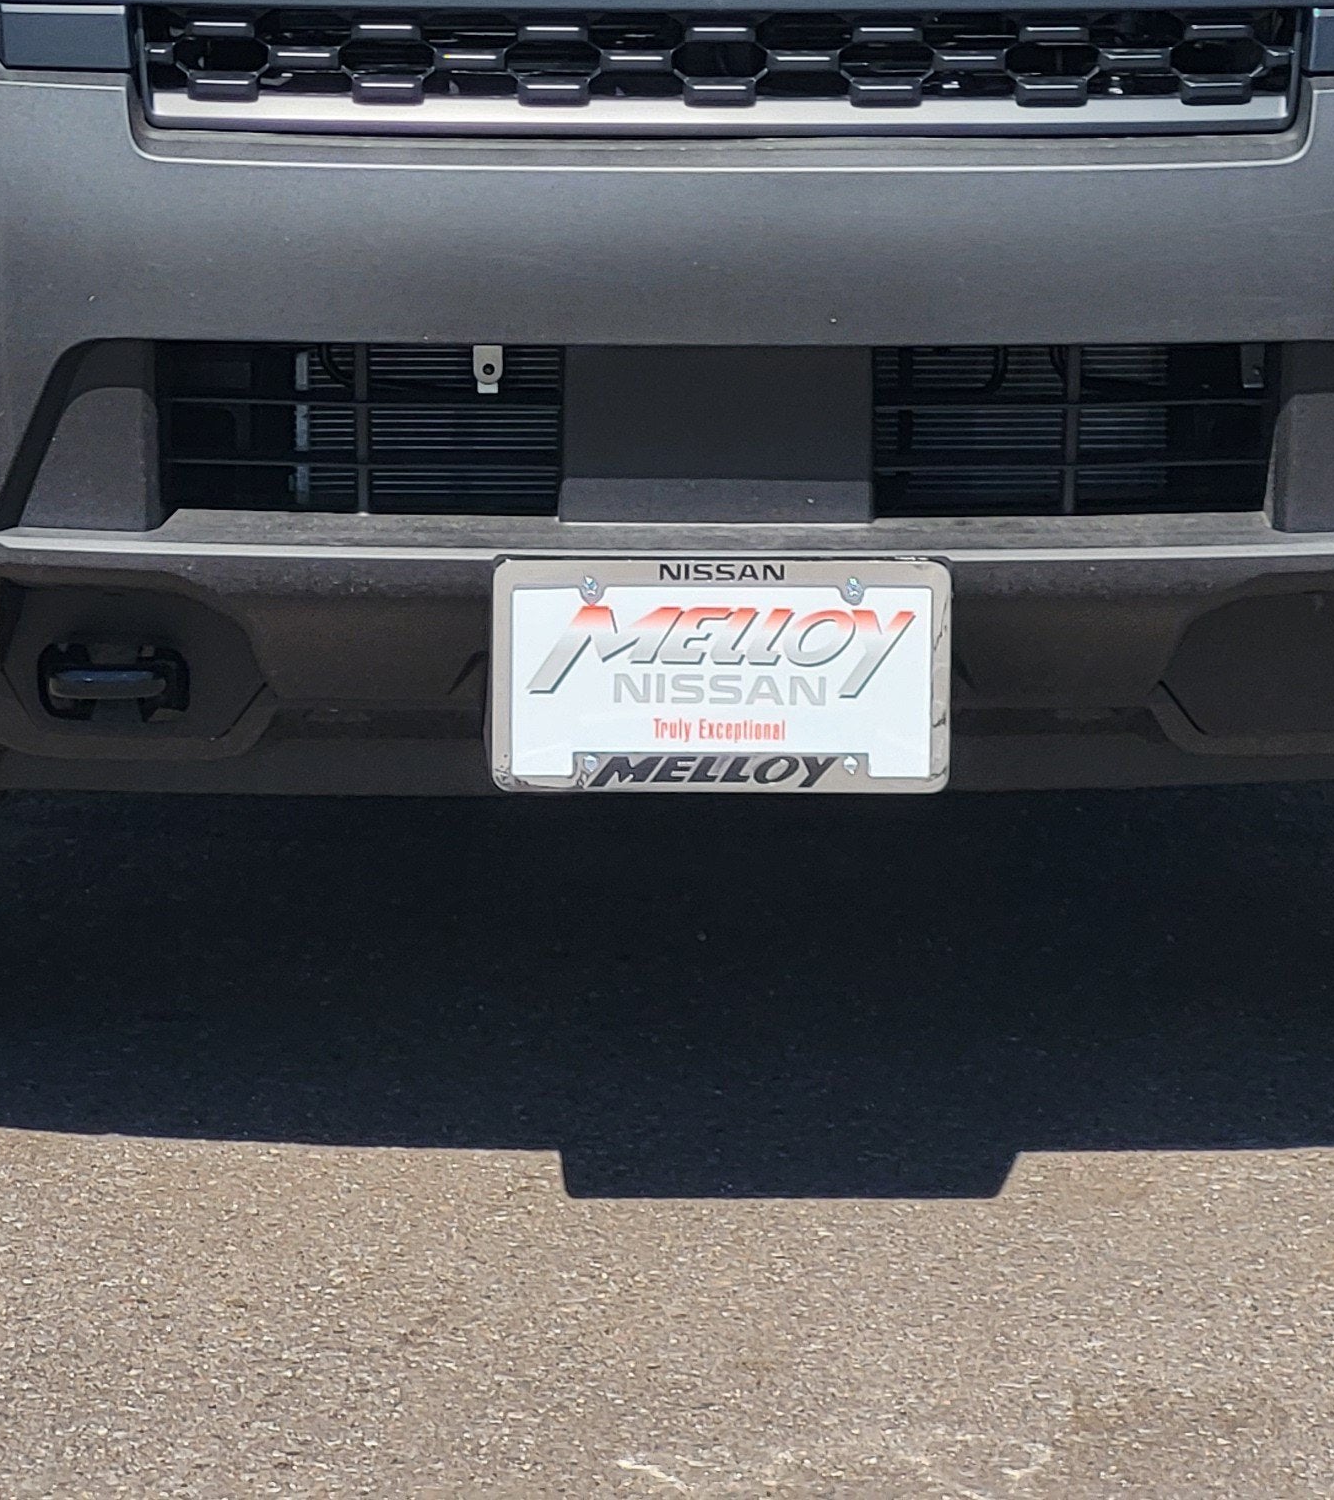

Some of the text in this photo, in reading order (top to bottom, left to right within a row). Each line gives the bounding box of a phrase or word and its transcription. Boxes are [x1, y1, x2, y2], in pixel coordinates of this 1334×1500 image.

[659, 563, 785, 581] NISSAN
[526, 605, 916, 699] MELLOY
[613, 673, 827, 707] NISSAN
[654, 718, 786, 743] Truly Exceptional
[588, 756, 840, 788] MELLOY
